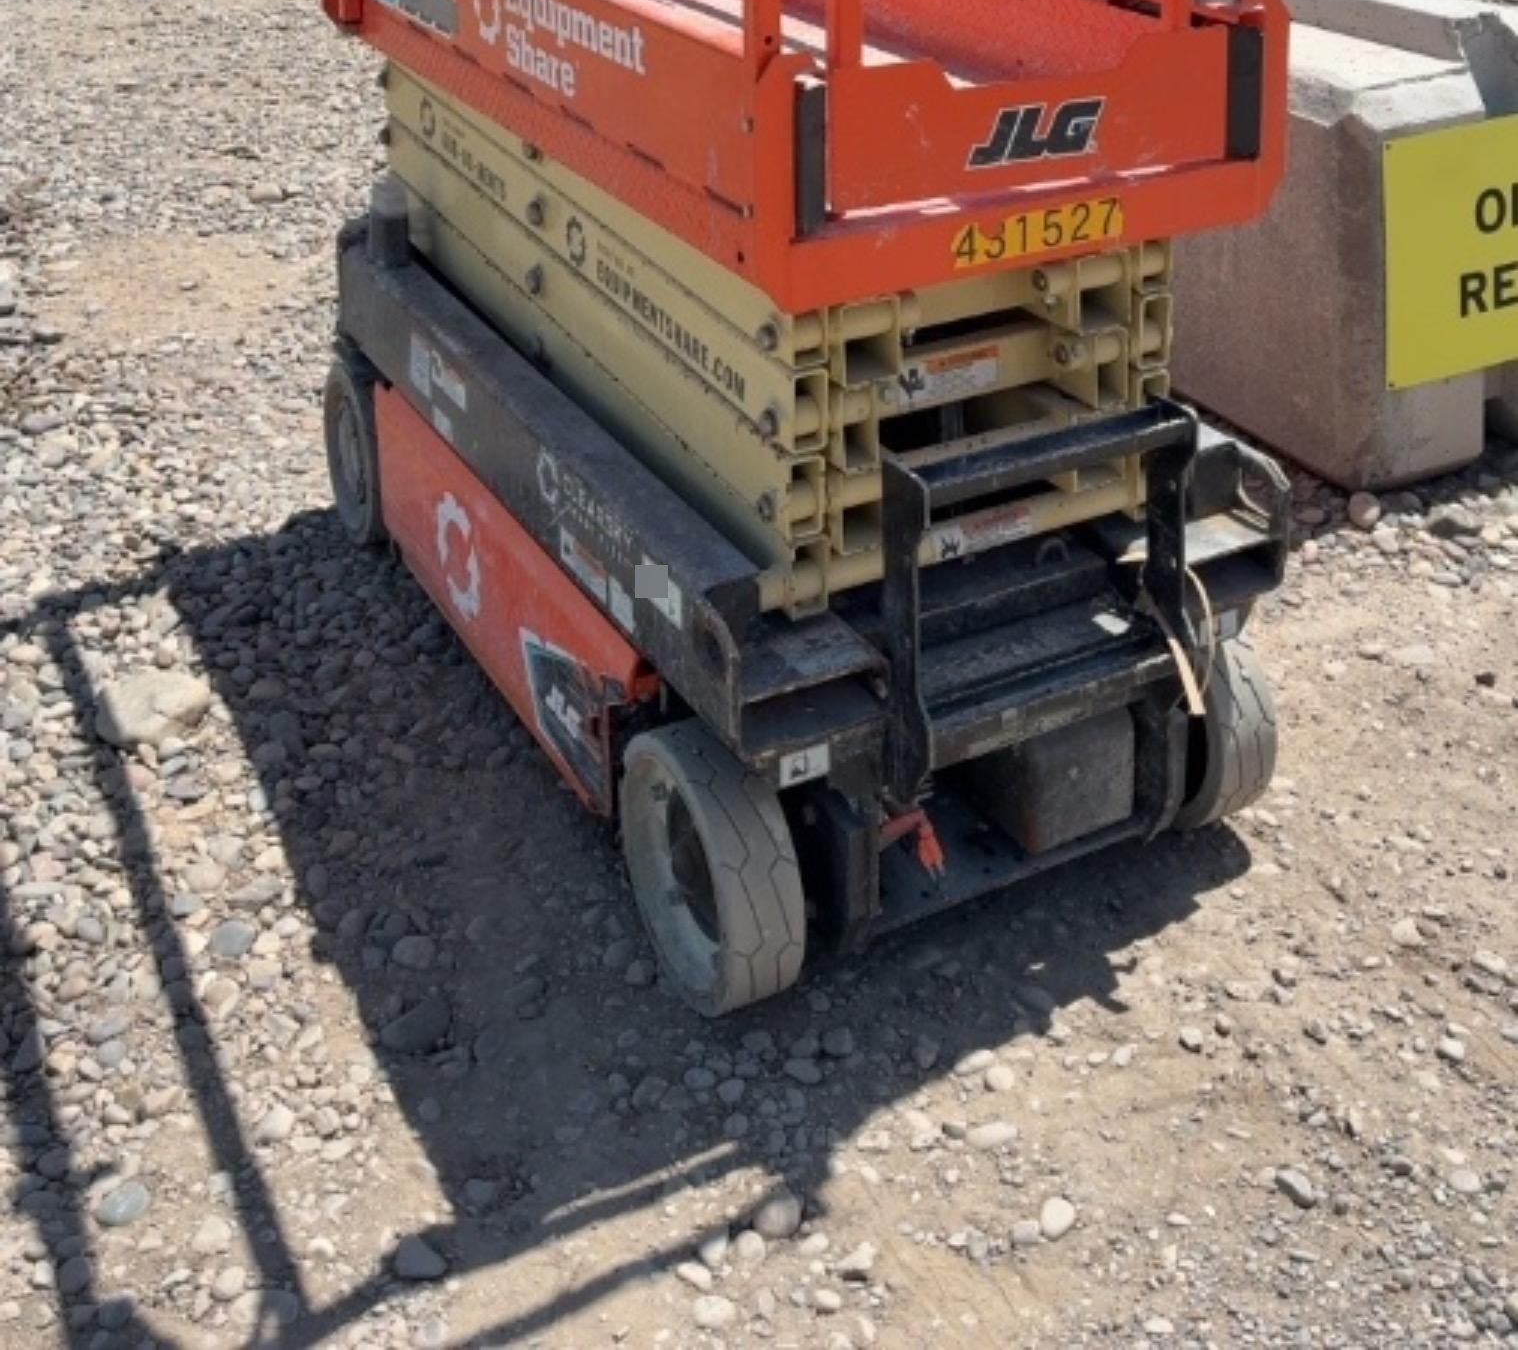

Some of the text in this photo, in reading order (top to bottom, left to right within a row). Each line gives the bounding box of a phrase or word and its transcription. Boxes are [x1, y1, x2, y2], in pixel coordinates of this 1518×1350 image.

[506, 23, 577, 98] Share
[964, 96, 1107, 171] JLG
[1474, 183, 1518, 235] O
